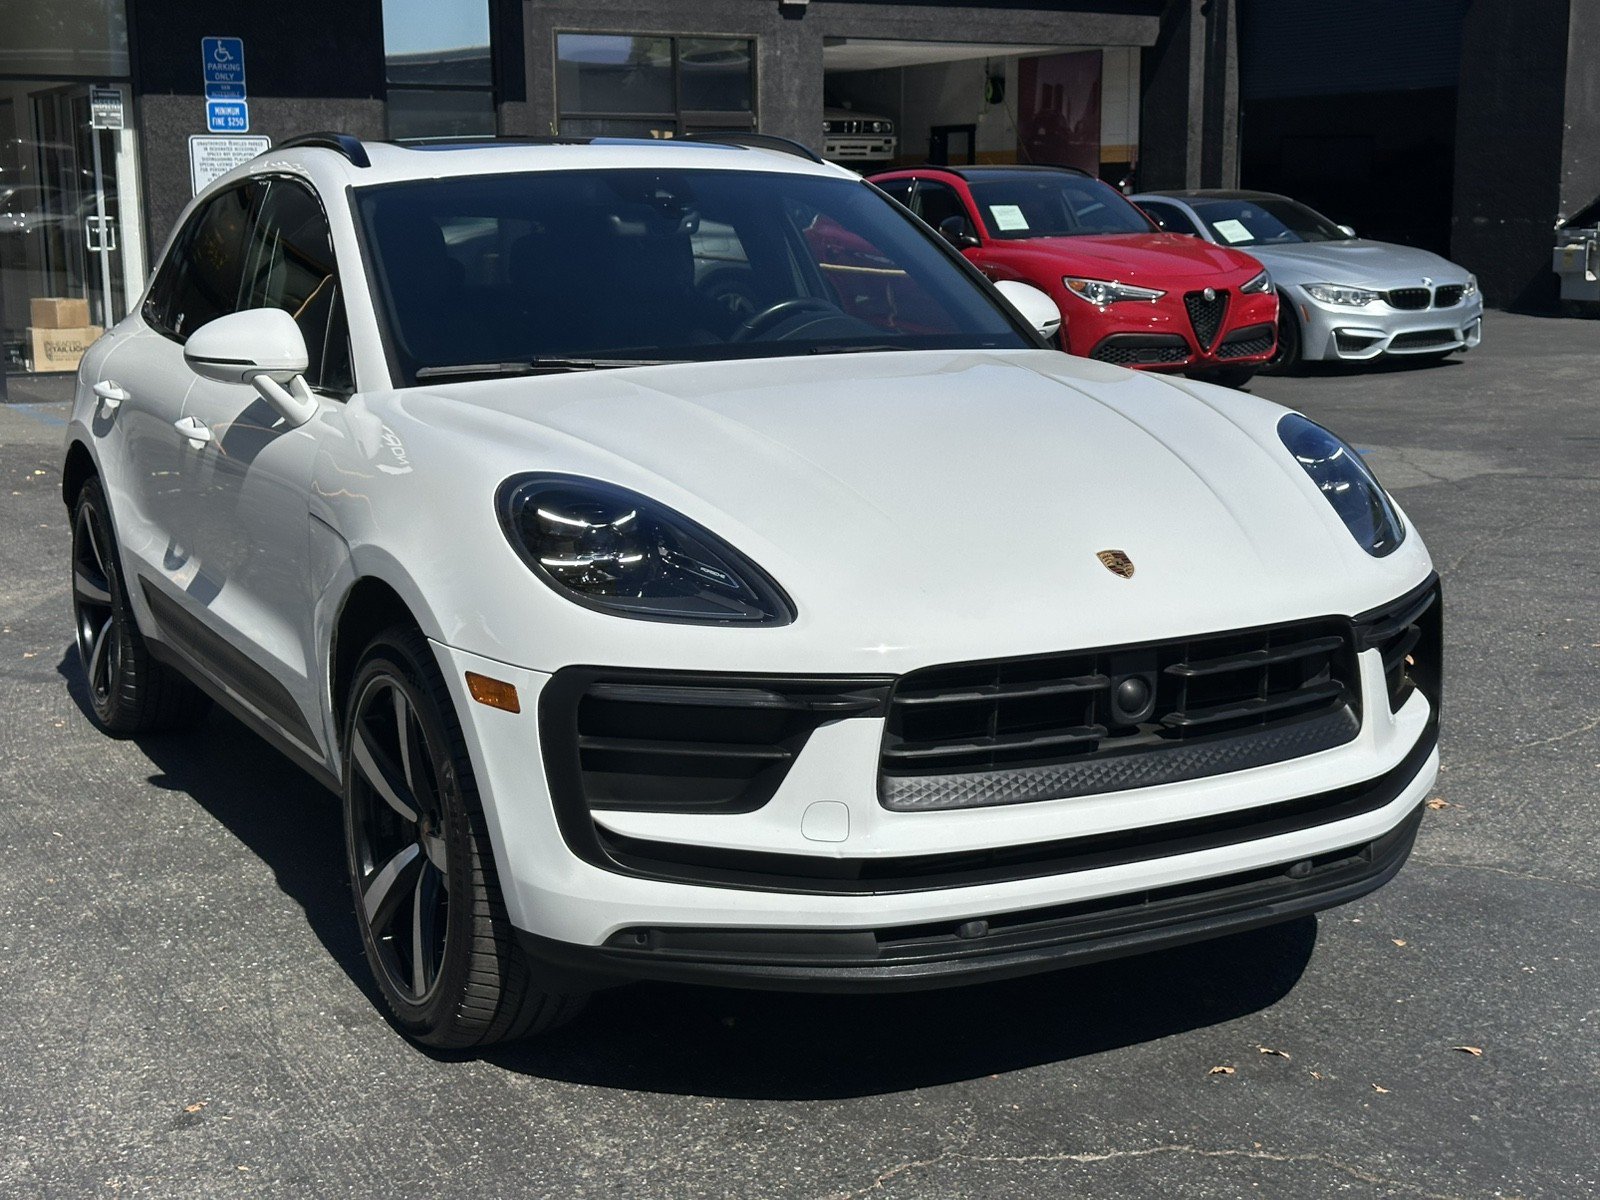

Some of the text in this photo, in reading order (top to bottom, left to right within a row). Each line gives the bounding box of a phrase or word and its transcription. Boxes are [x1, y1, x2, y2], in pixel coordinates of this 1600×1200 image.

[208, 63, 240, 71] PARKING
[214, 107, 240, 116] MINIMUM
[212, 117, 244, 127] FINE $250
[700, 566, 726, 579] PORSCHE
